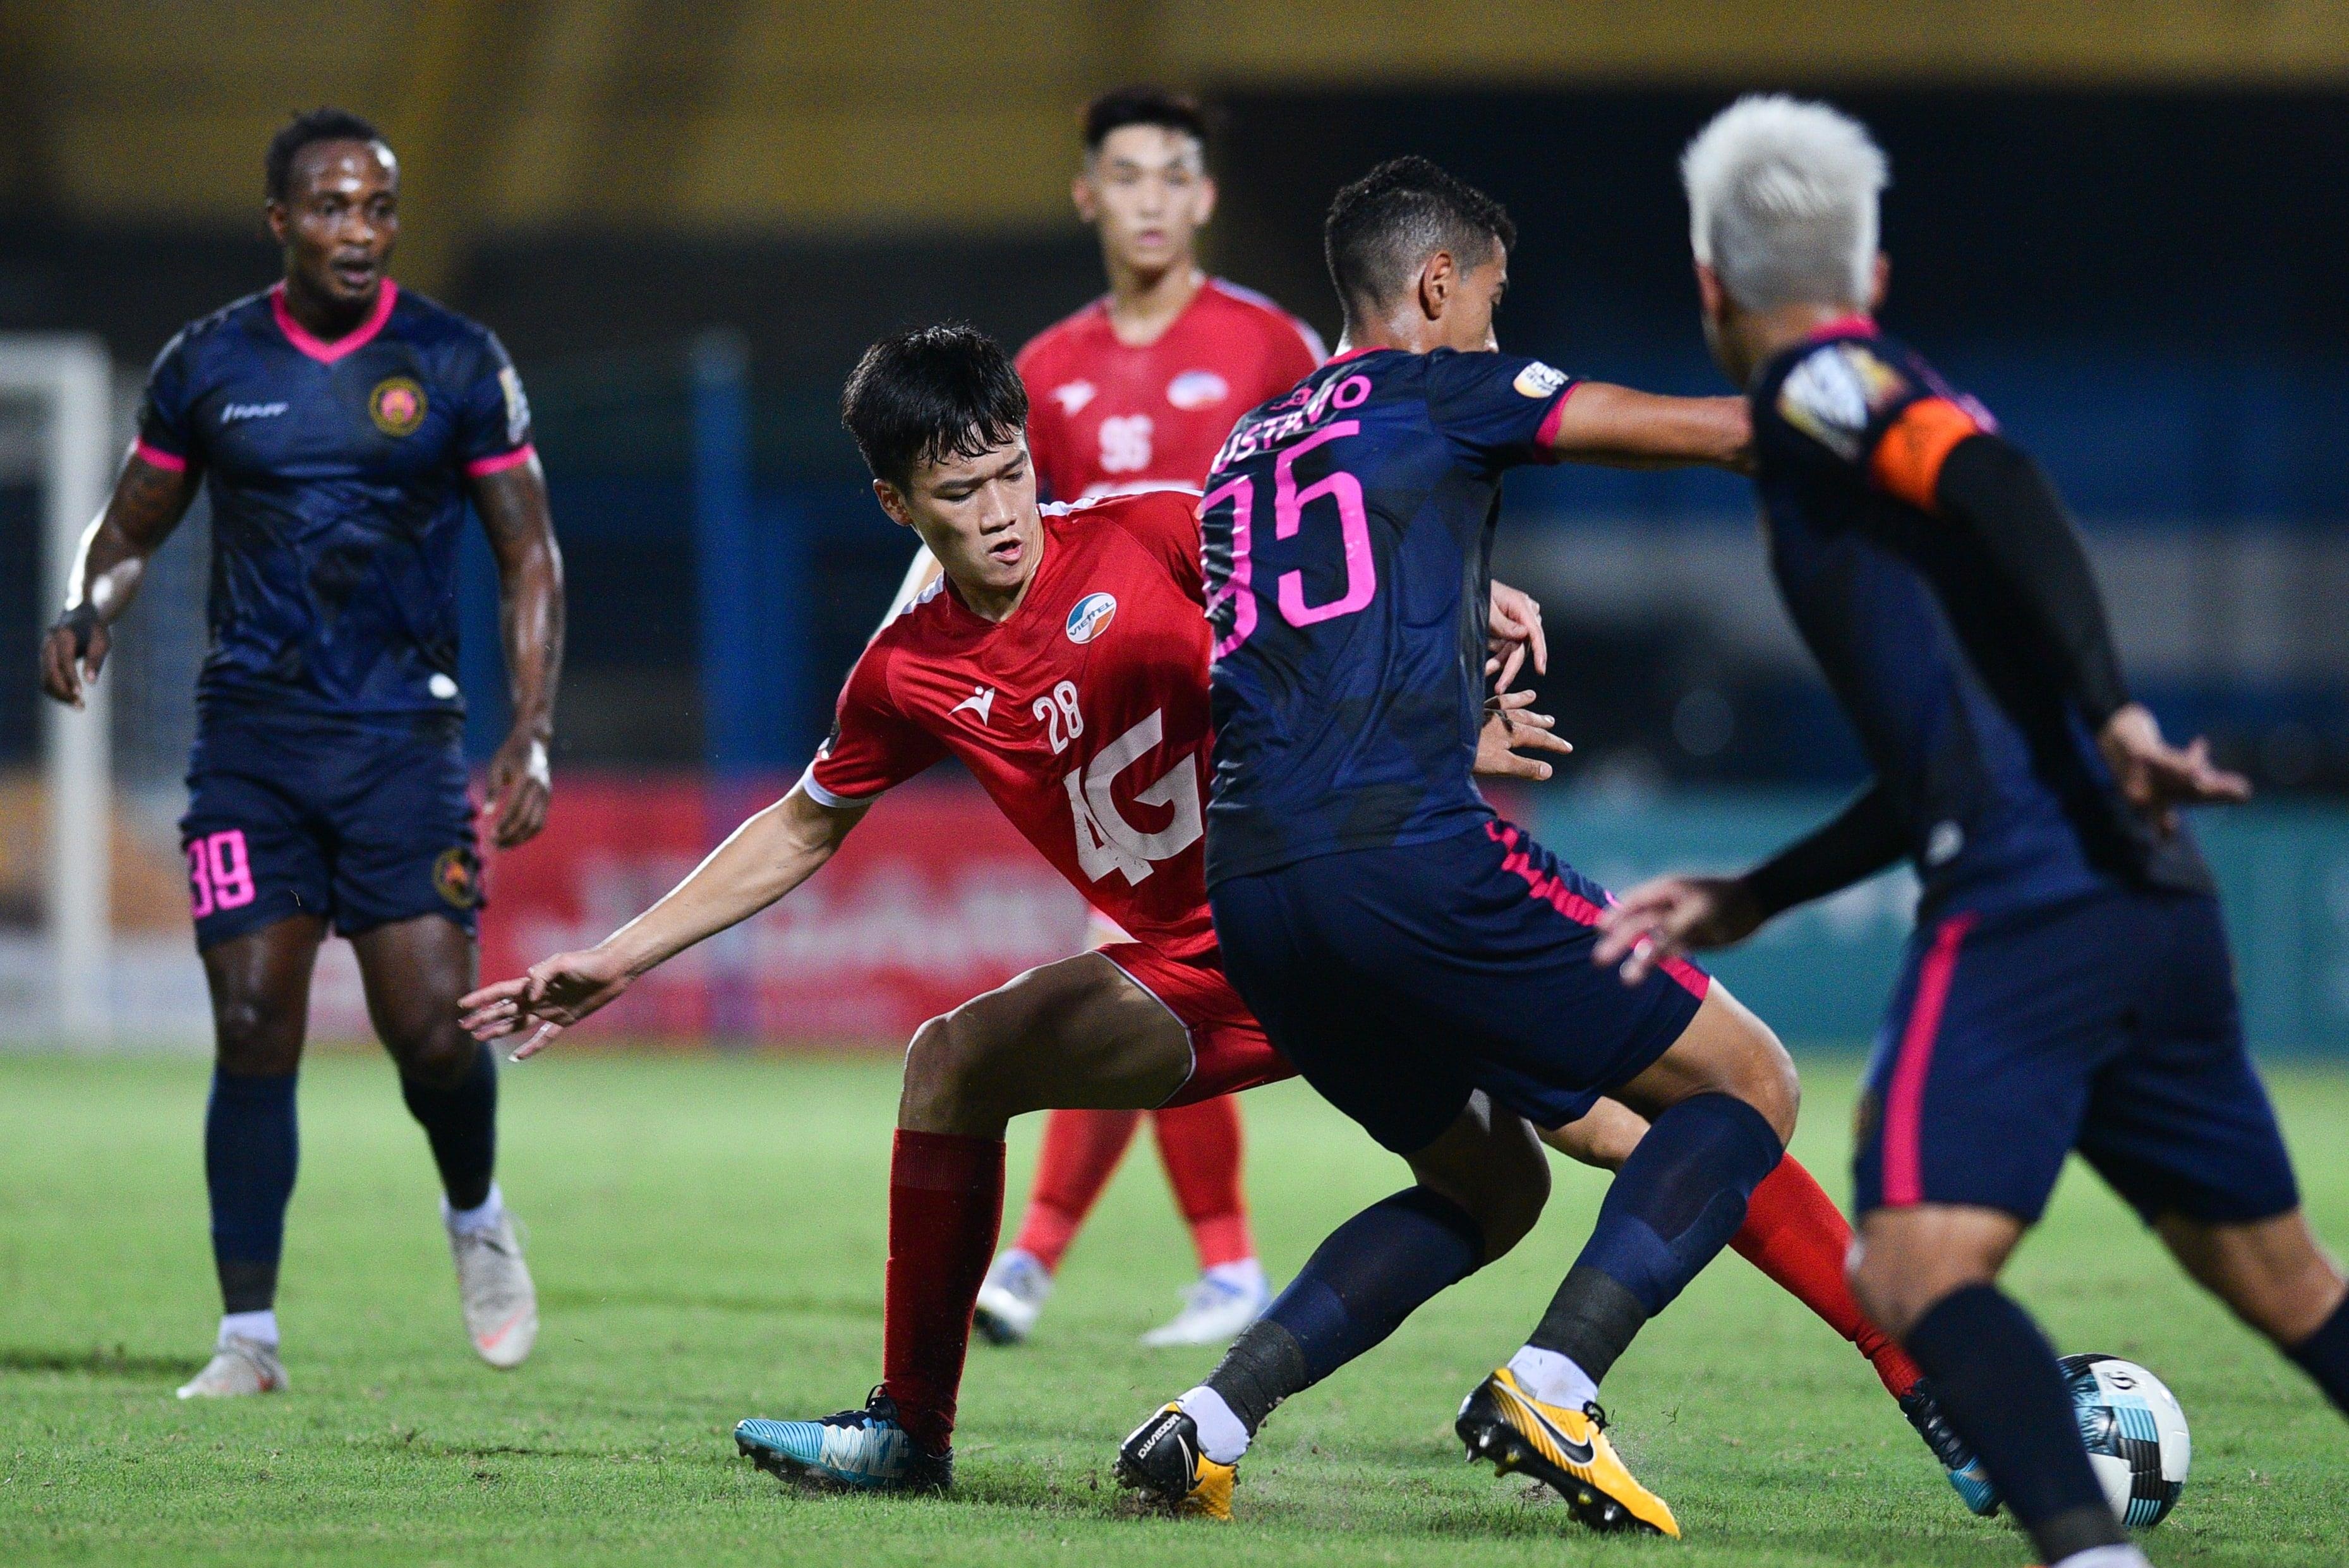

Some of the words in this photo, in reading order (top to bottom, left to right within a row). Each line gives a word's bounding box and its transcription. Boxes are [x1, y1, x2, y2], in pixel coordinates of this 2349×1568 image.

[1069, 602, 1114, 636] VIETTEL
[1032, 680, 1084, 754] 28
[1063, 707, 1204, 887] 4G
[188, 829, 256, 920] 39
